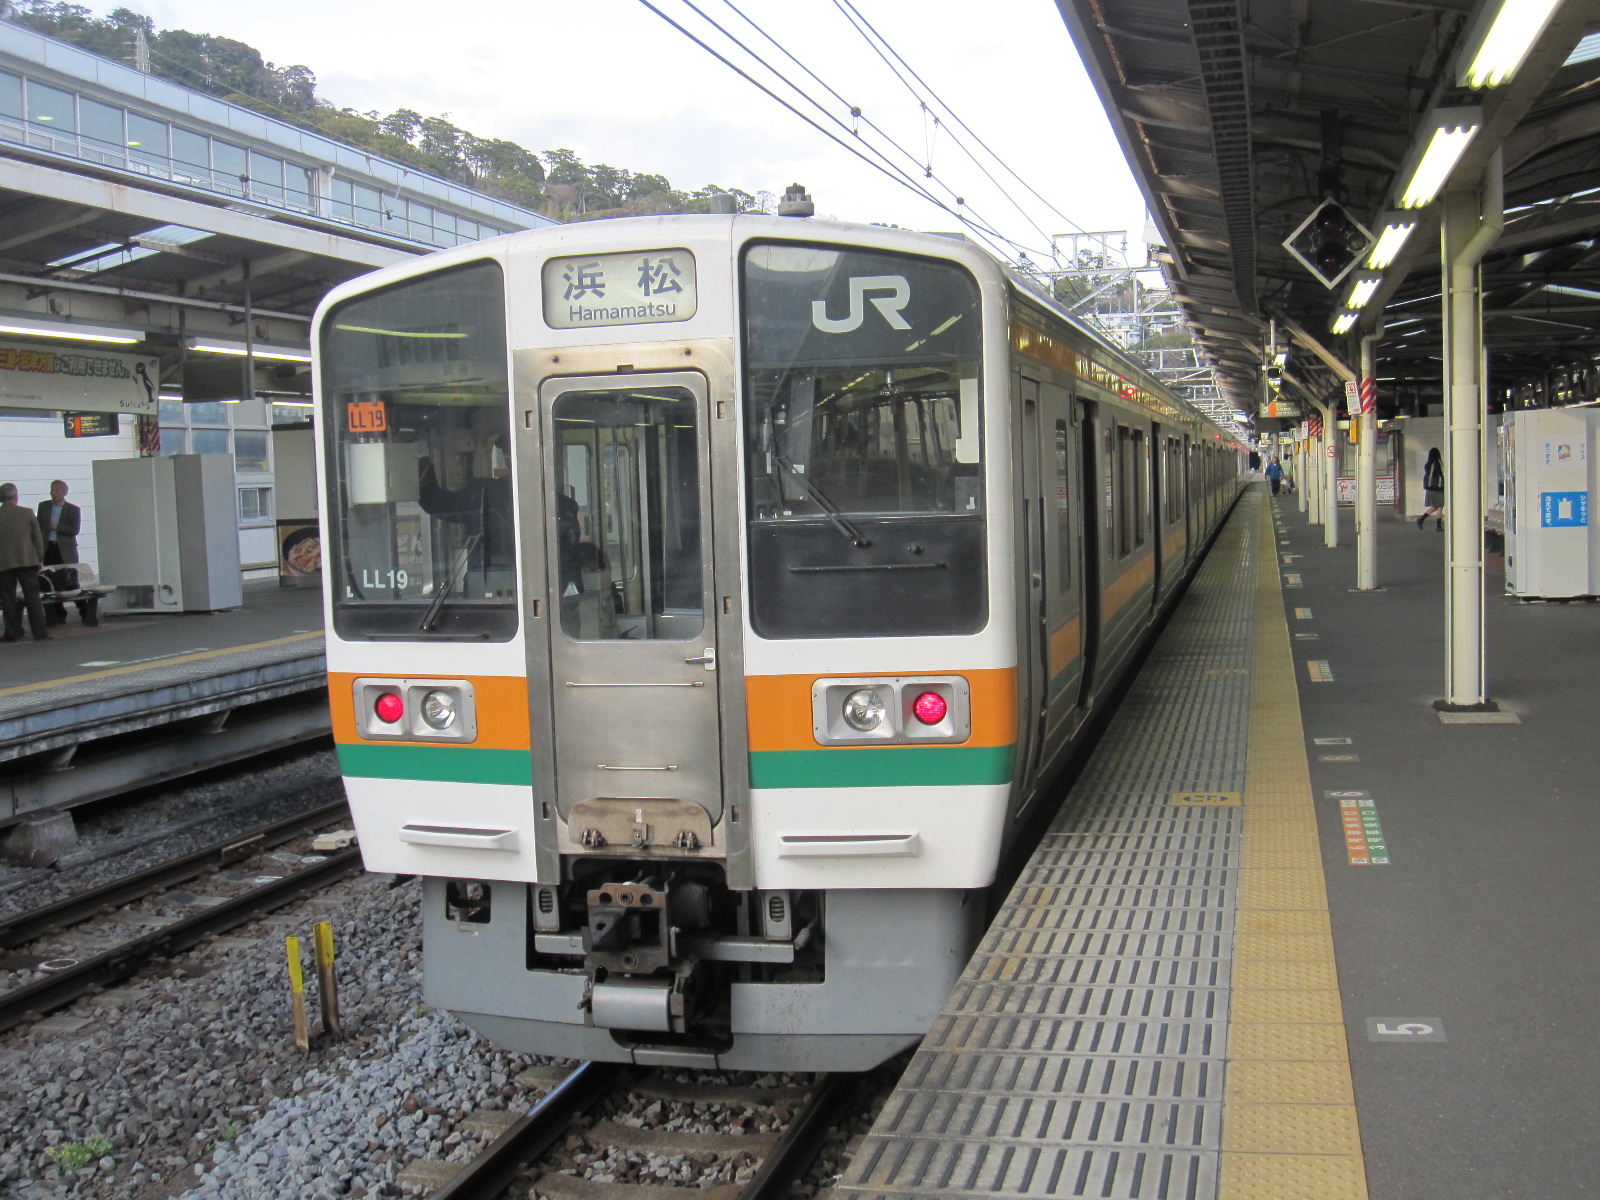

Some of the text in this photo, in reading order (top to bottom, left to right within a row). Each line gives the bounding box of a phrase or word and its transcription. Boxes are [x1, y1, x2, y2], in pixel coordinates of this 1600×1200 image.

[562, 257, 683, 301] 浜松
[569, 301, 676, 322] Hamamatsu
[812, 275, 912, 334] JR
[67, 417, 75, 430] 5
[350, 409, 384, 428] LL 19
[363, 569, 408, 589] LL19
[1376, 1023, 1434, 1035] 5
